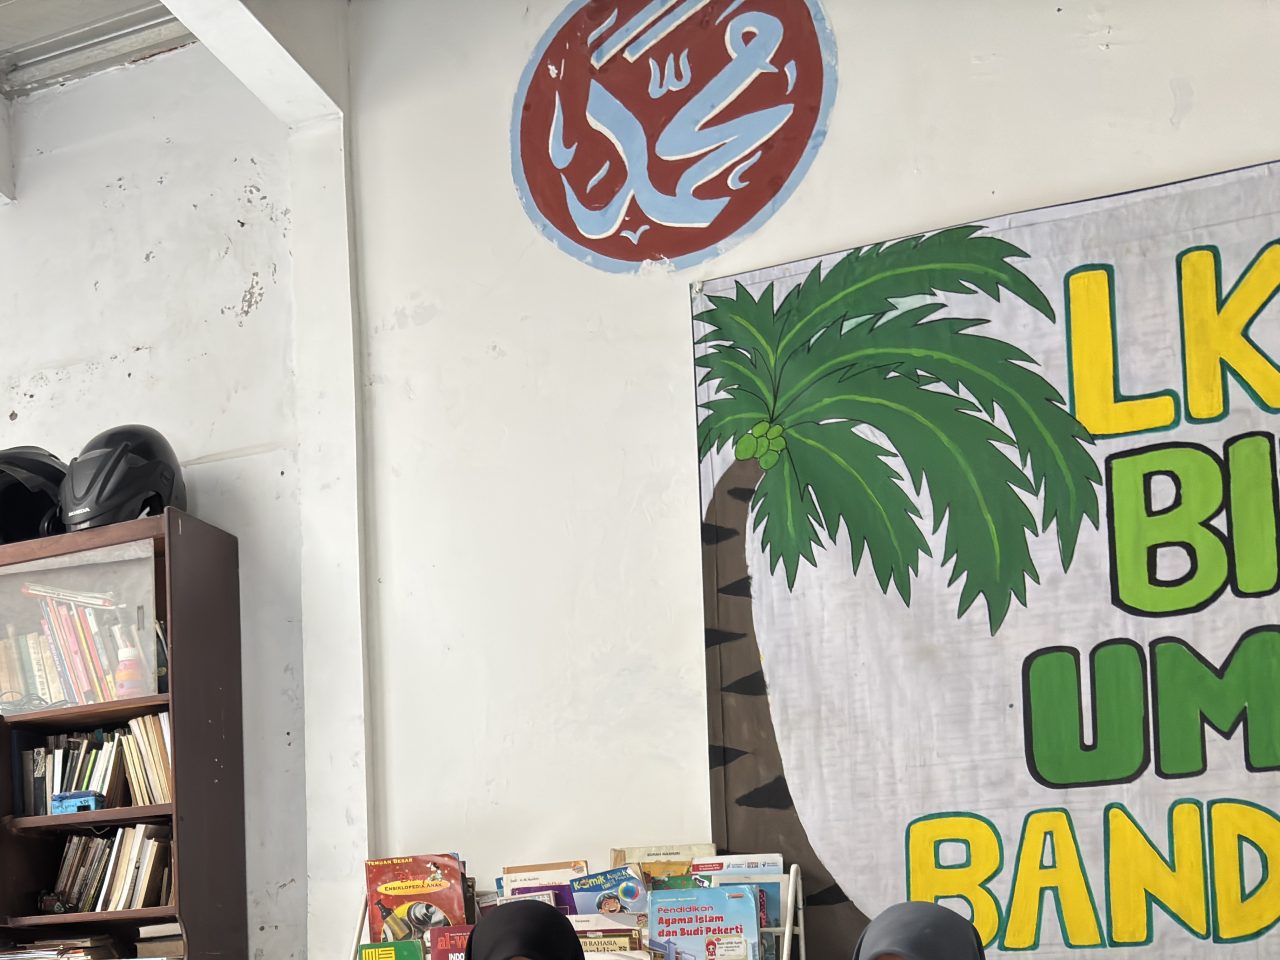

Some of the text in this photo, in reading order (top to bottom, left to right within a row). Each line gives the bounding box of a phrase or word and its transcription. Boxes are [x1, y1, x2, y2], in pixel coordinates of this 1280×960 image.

[1064, 238, 1280, 439] LK
[1105, 431, 1280, 617] BI
[1022, 624, 1280, 789] UM
[657, 904, 714, 914] Pendidikan
[905, 798, 1280, 951] BAND
[588, 939, 618, 947] RAHASIA
[657, 924, 744, 938] dan Budi Pekerti
[658, 914, 724, 928] Agama Islam
